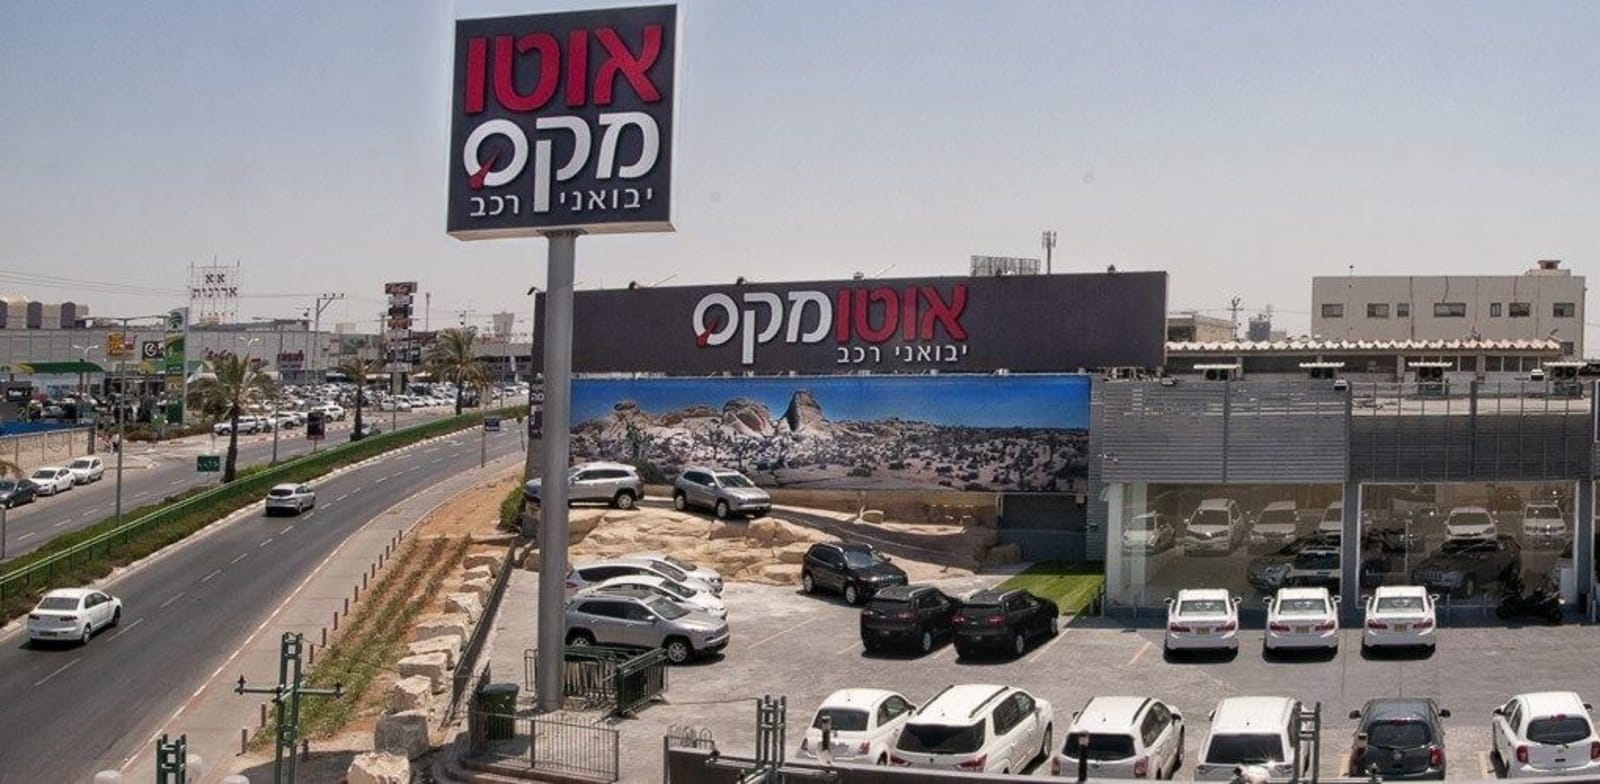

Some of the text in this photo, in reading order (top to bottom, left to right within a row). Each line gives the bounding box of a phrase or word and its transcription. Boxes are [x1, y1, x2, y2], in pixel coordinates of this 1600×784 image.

[465, 24, 663, 113] אוטו
[463, 111, 660, 213] מקס
[470, 188, 653, 217] יבואני רכב
[837, 344, 968, 363] יבואני רכב
